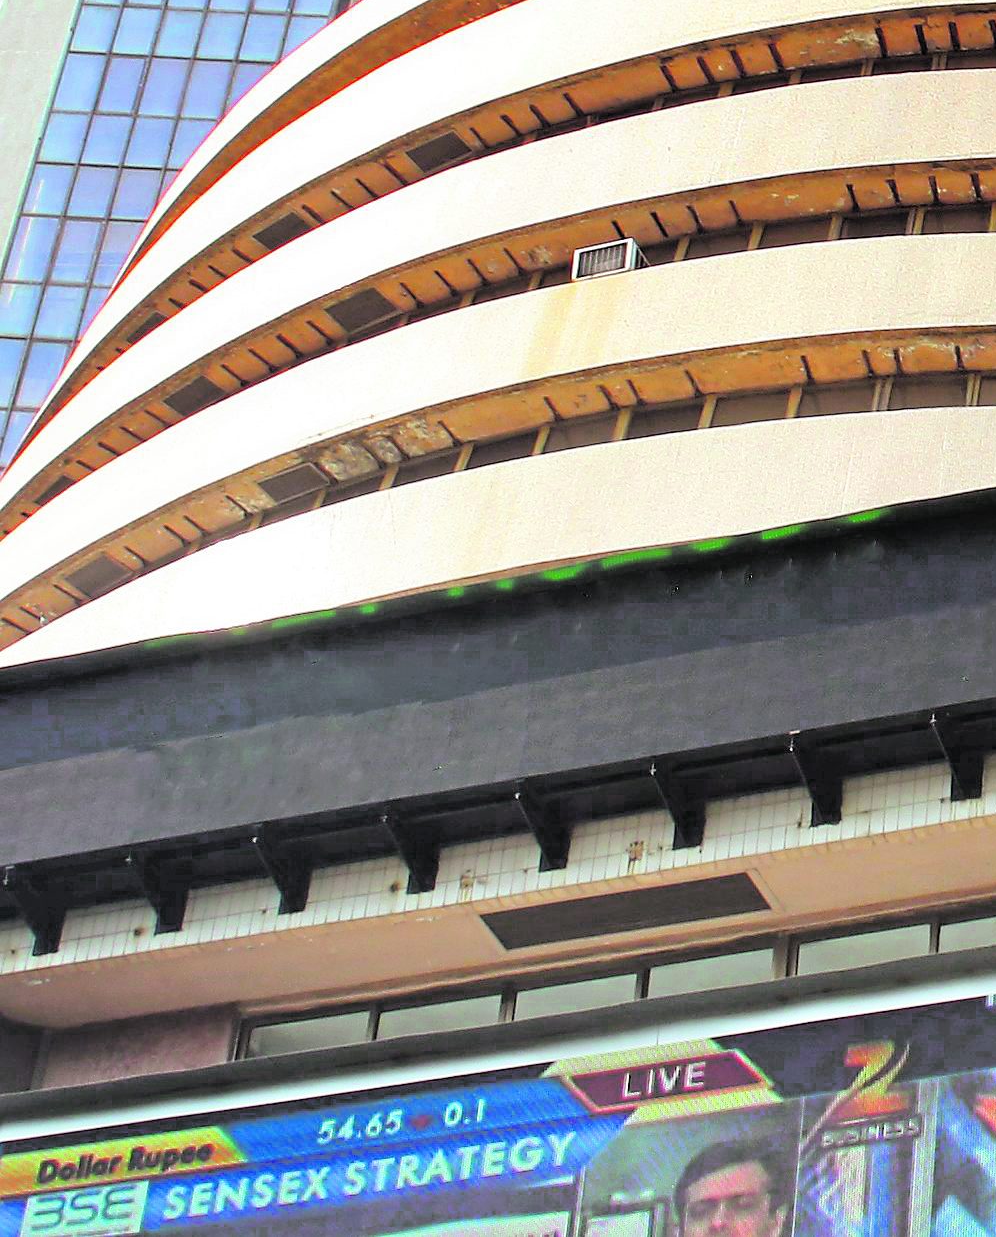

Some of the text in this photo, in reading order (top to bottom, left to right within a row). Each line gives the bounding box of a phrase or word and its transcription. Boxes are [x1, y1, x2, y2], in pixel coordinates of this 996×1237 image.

[621, 1061, 706, 1099] LIVE
[317, 1098, 487, 1144] 54.65 0.1
[37, 1143, 216, 1183] Dollar Rupee
[163, 1130, 577, 1221] SENSEX STRATEGY
